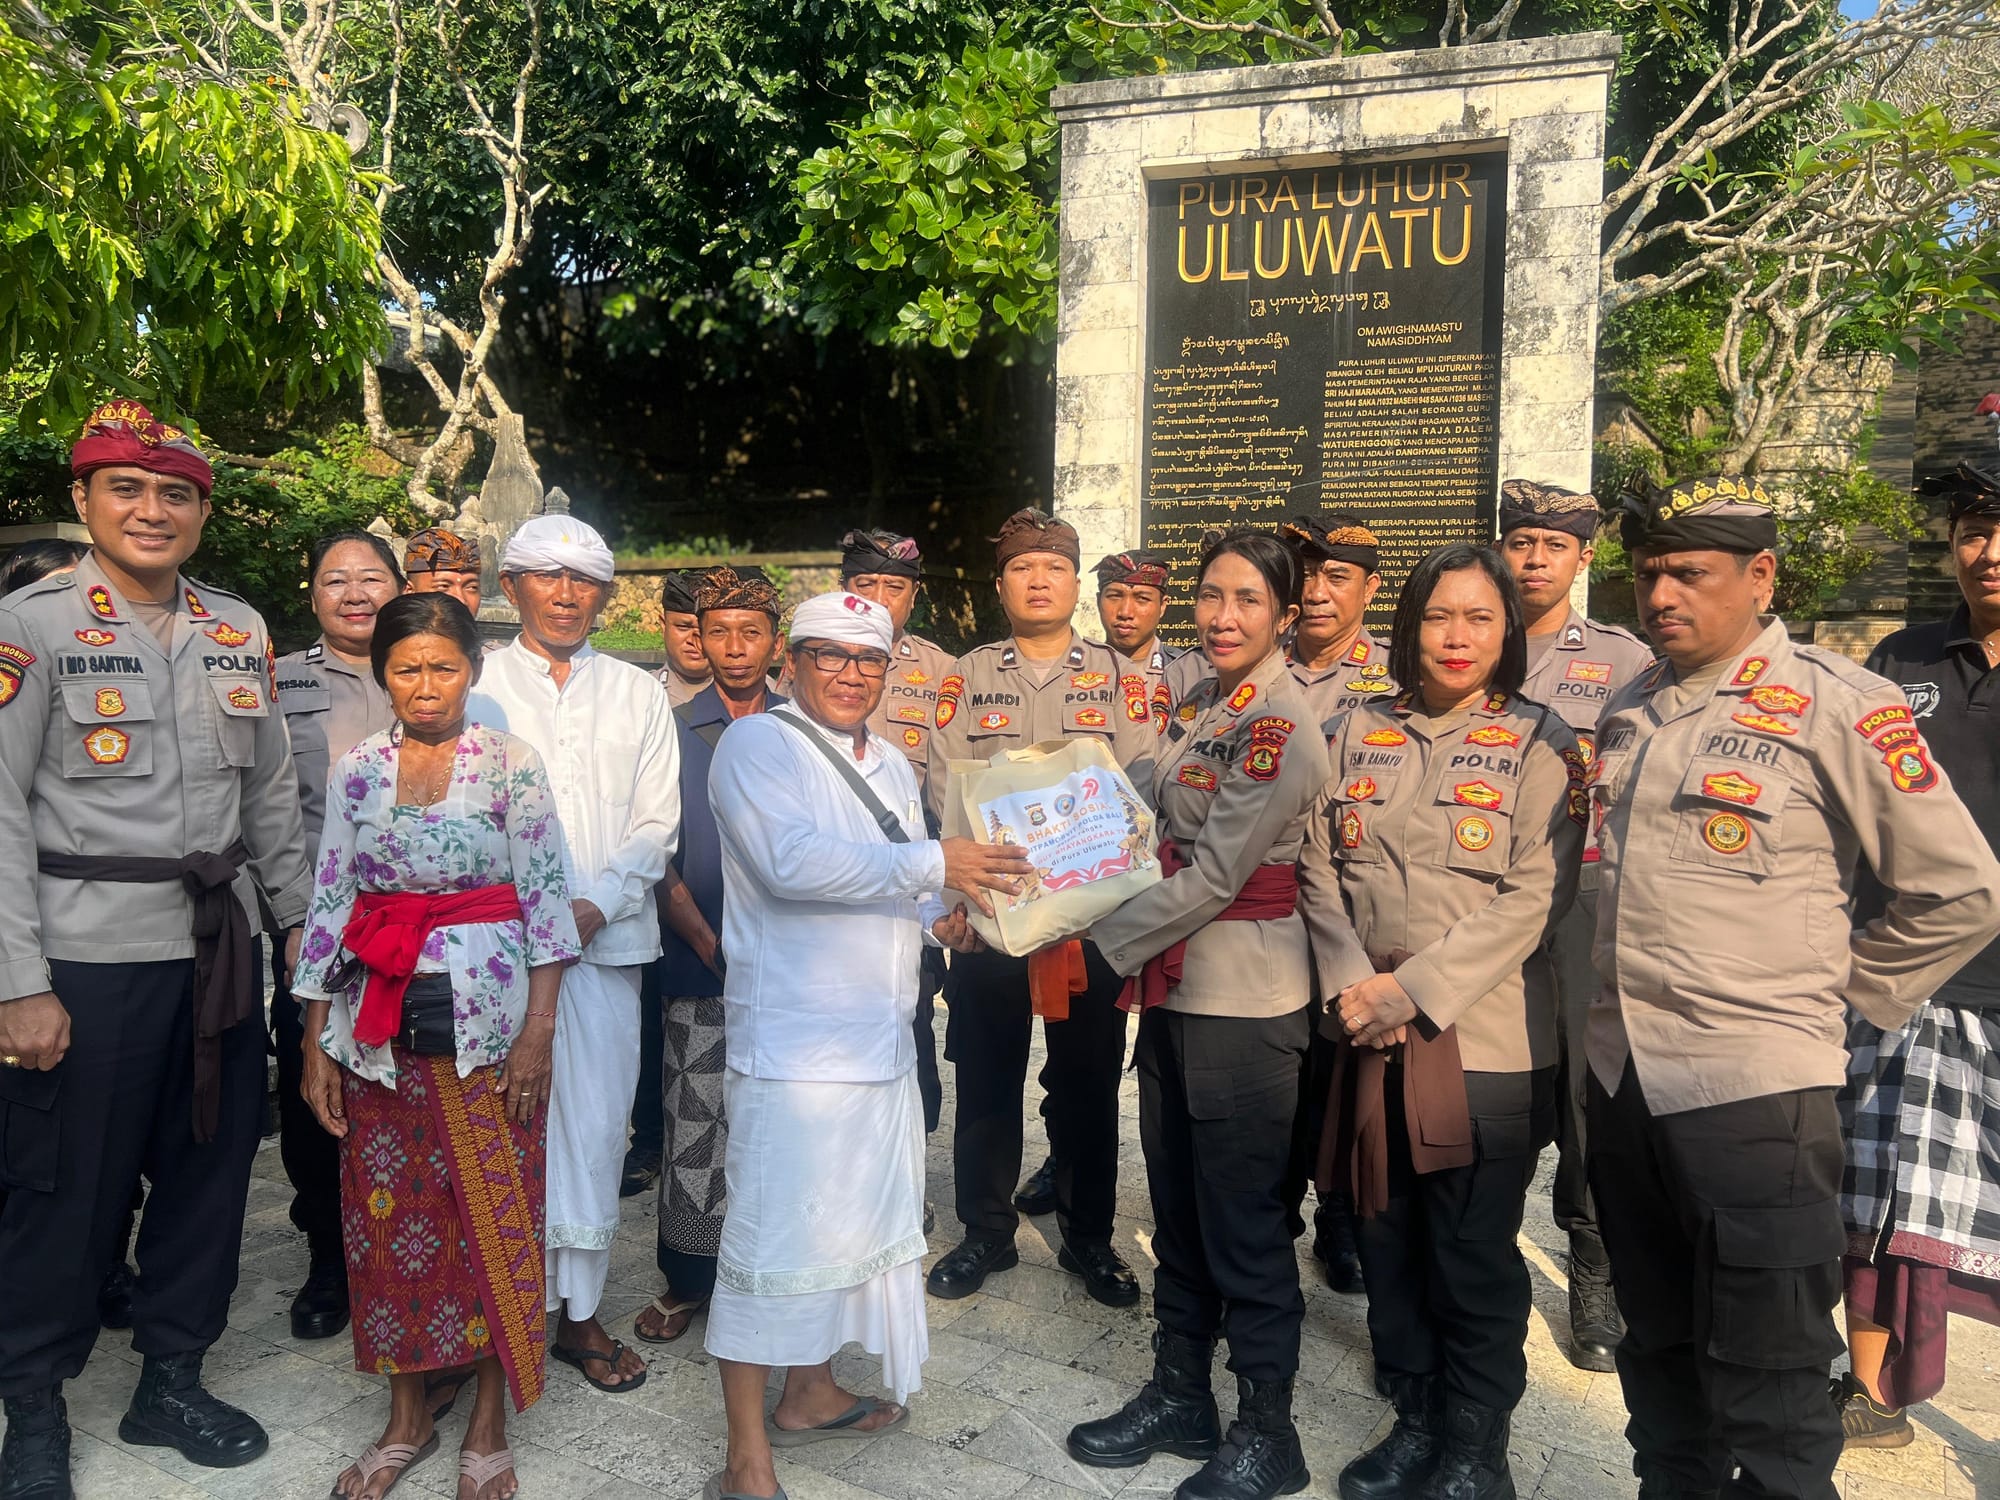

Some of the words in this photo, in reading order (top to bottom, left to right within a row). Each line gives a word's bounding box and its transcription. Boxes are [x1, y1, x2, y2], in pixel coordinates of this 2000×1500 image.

[1178, 175, 1300, 220] PURA
[1311, 162, 1473, 210] LUHUR
[1177, 204, 1472, 284] ULUWATU
[1357, 327, 1375, 337] OM
[1376, 322, 1463, 335] AWIGHNAMASTU
[1367, 334, 1452, 348] NAMASIDDHYAM
[1360, 358, 1386, 366] LUHUR
[1387, 356, 1424, 365] ULUWATU
[1425, 355, 1437, 363] INI
[1438, 353, 1496, 362] DIPERKIRAKAN
[1326, 369, 1363, 378] DIBANGUN
[1364, 368, 1385, 376] OLEH
[1388, 367, 1414, 375] BELIAU
[1416, 365, 1434, 373] MPU
[1434, 363, 1472, 373] KUTURAN
[1474, 363, 1495, 371] PADA
[1347, 378, 1407, 387] PEMERINTAHAN
[1407, 376, 1428, 384] RAJA
[1428, 375, 1451, 383] YANG
[1452, 373, 1495, 382] BERGELAR
[1324, 389, 1337, 397] SRI
[1338, 388, 1354, 397] HAJI
[1355, 387, 1397, 396] MARAKATA,
[1420, 385, 1468, 394] MEMERINTAH
[1324, 400, 1345, 408] TAHUN
[1357, 398, 1376, 407] SAKA
[1430, 395, 1448, 403] SAKA
[1324, 410, 1353, 418] BELIAU
[1356, 409, 1389, 417] ADALAH
[1422, 405, 1464, 414] SEORANG
[1324, 421, 1361, 429] SPIRITUAL
[1361, 420, 1400, 428] KERAJAAN
[1323, 431, 1347, 439] MASA
[1350, 429, 1418, 438] PEMERINTAHAN
[1422, 426, 1451, 435] RAJA
[1455, 425, 1493, 434] DALEM
[1403, 438, 1423, 446] YANG
[1424, 437, 1464, 446] MENCAPAI
[1322, 451, 1331, 459] DI
[1354, 450, 1365, 458] INI
[1395, 447, 1447, 457] DANGHYANG
[1448, 446, 1489, 455] NIRARTHA
[1347, 460, 1359, 468] INI
[1362, 459, 1408, 468] DIBANGUN
[1452, 457, 1487, 465] TEMPAT
[1362, 470, 1379, 478] RAJA
[1383, 469, 1401, 477] RAJA
[1401, 468, 1435, 476] LELUHUR
[1435, 467, 1461, 475] BELIAU
[1321, 482, 1357, 490] KEMUDIAN
[1358, 481, 1378, 489] PURA
[1389, 480, 1420, 488] SEBAGAI
[1339, 491, 1362, 499] STANA
[1392, 490, 1417, 498] RUDRA
[1418, 489, 1435, 497] DAN
[1435, 489, 1456, 497] JUGA
[1320, 501, 1348, 509] TEMPAT
[1390, 499, 1437, 508] DANGHYANG
[1369, 519, 1407, 527] BEBERAPA
[1440, 518, 1462, 526] PURA
[1398, 539, 1419, 547] DANG
[58, 656, 64, 676] I
[66, 656, 87, 674] MD
[90, 655, 144, 675] SANTIKA
[202, 654, 262, 673] POLRI
[891, 685, 937, 702] POLRI
[1065, 690, 1113, 704] POLRI
[1556, 682, 1612, 702] POLRI
[971, 693, 1020, 707] MARDI
[1254, 719, 1291, 730] POLDA
[1862, 709, 1906, 732] POLDA
[1254, 732, 1284, 742] BALI
[1881, 730, 1911, 744] BALI
[1705, 734, 1781, 767] POLRI
[1367, 751, 1404, 768] RAHAYU
[1450, 753, 1519, 778] POLRI
[1026, 819, 1071, 843] BHAKTI
[1061, 851, 1081, 862] Pura
[1082, 839, 1116, 854] Uluwatu
